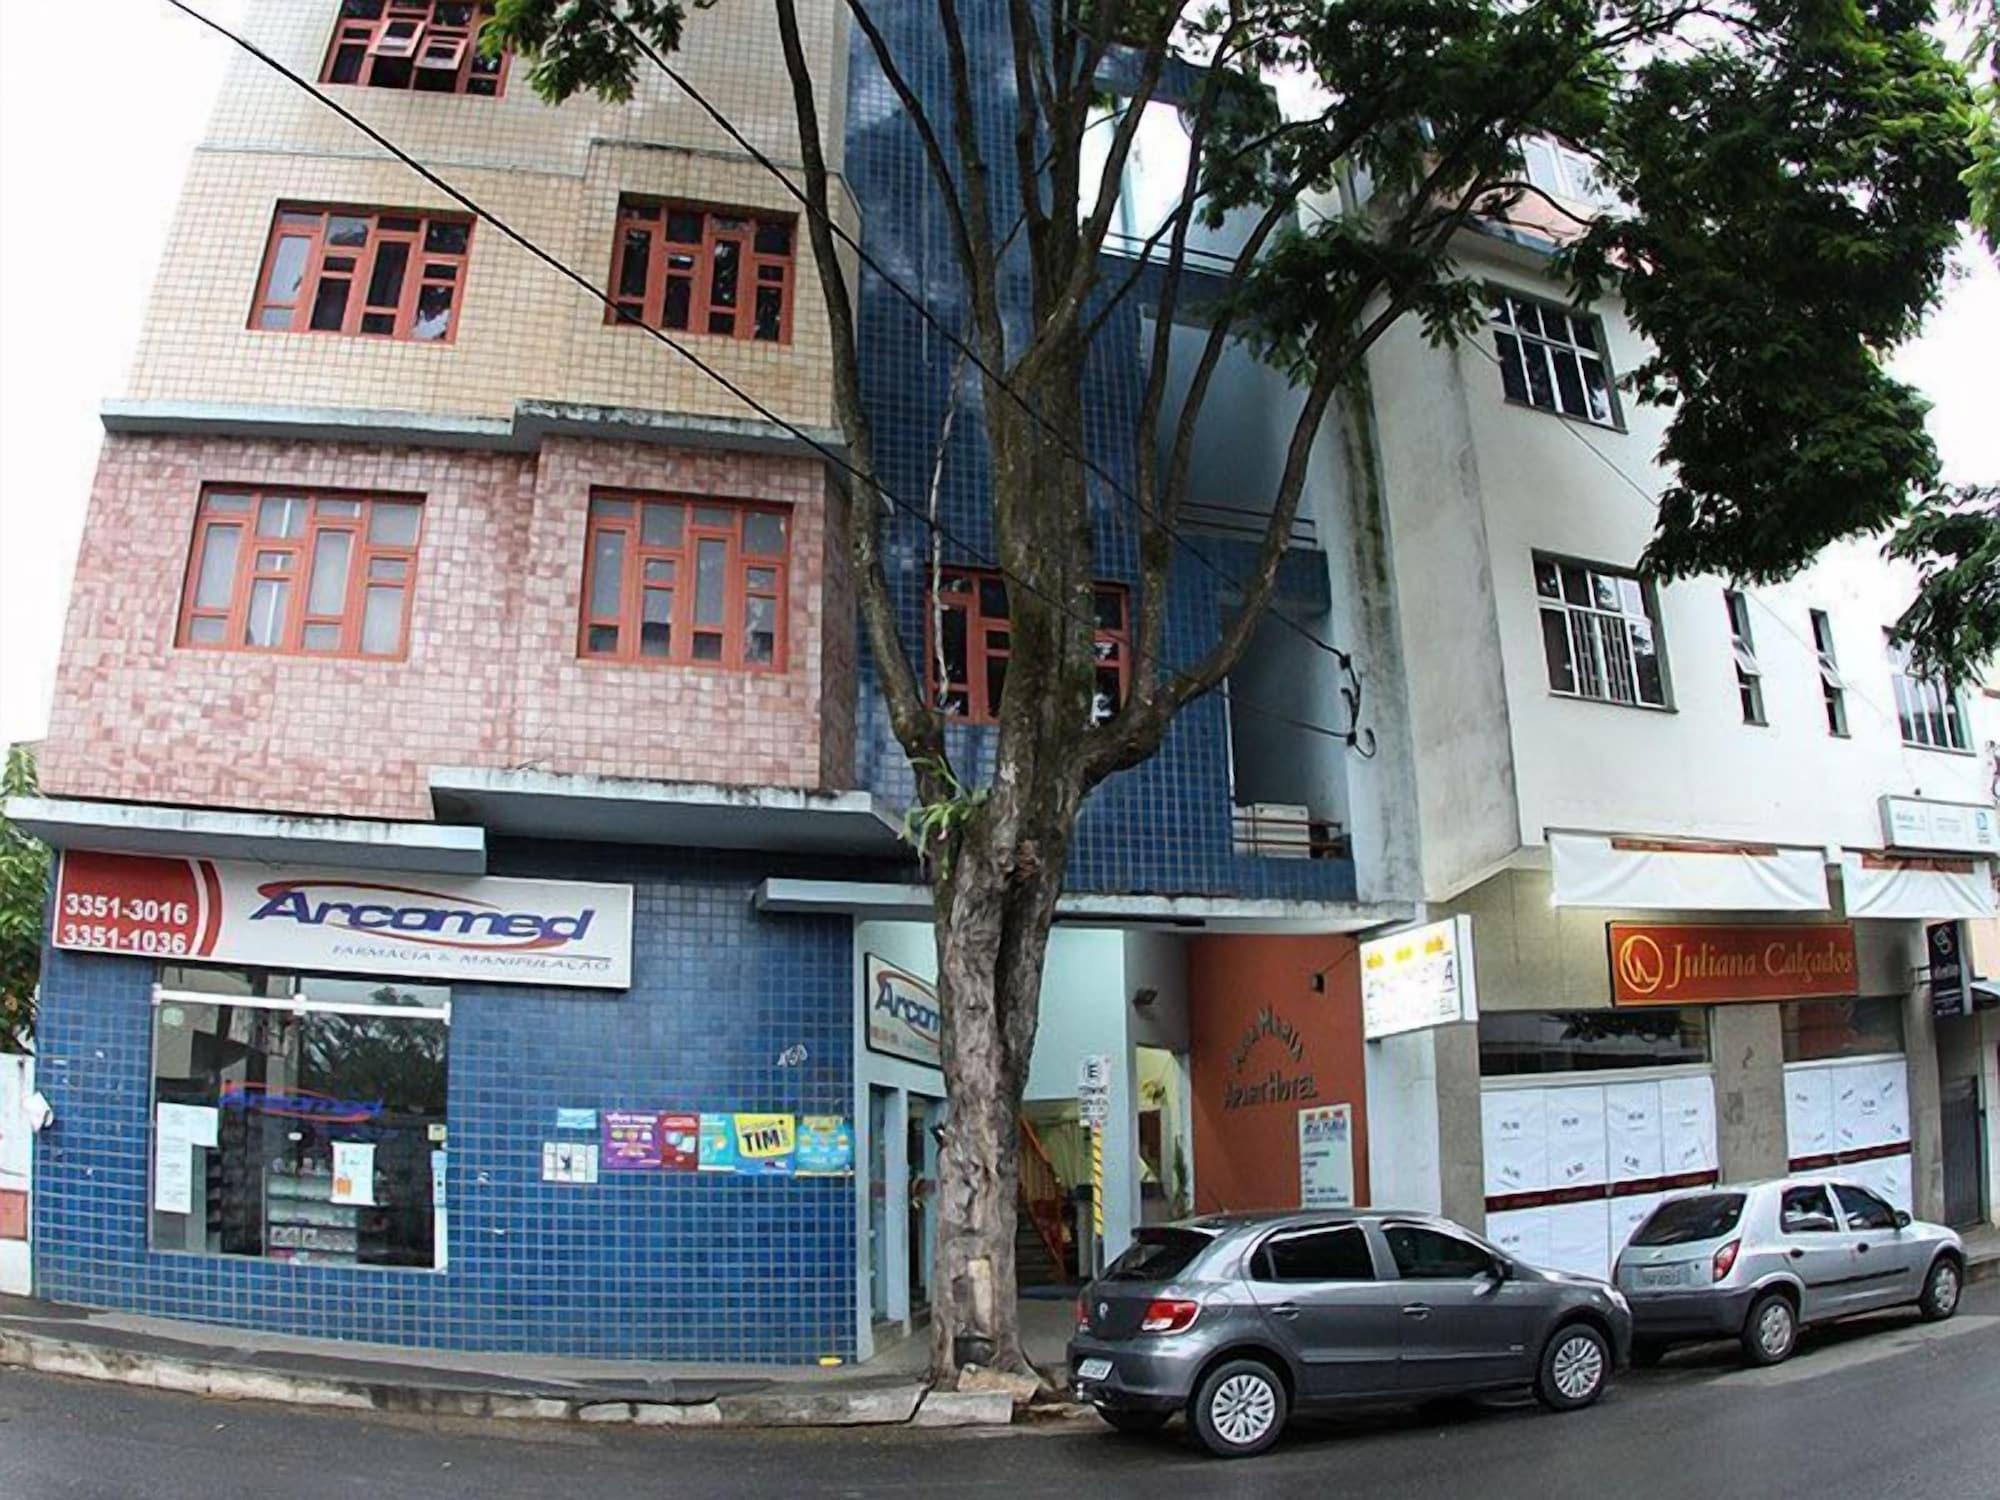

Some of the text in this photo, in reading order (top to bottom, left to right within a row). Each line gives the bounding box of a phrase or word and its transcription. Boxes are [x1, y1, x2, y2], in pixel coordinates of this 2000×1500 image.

[64, 893, 188, 925] 3351-3016
[249, 890, 595, 942] Arcomed
[63, 923, 187, 955] 3351-1036
[1665, 942, 1851, 989] Juliana Calçados
[875, 980, 940, 1033] Arcom
[1087, 1064, 1099, 1078] E
[742, 1129, 781, 1153] TIM
